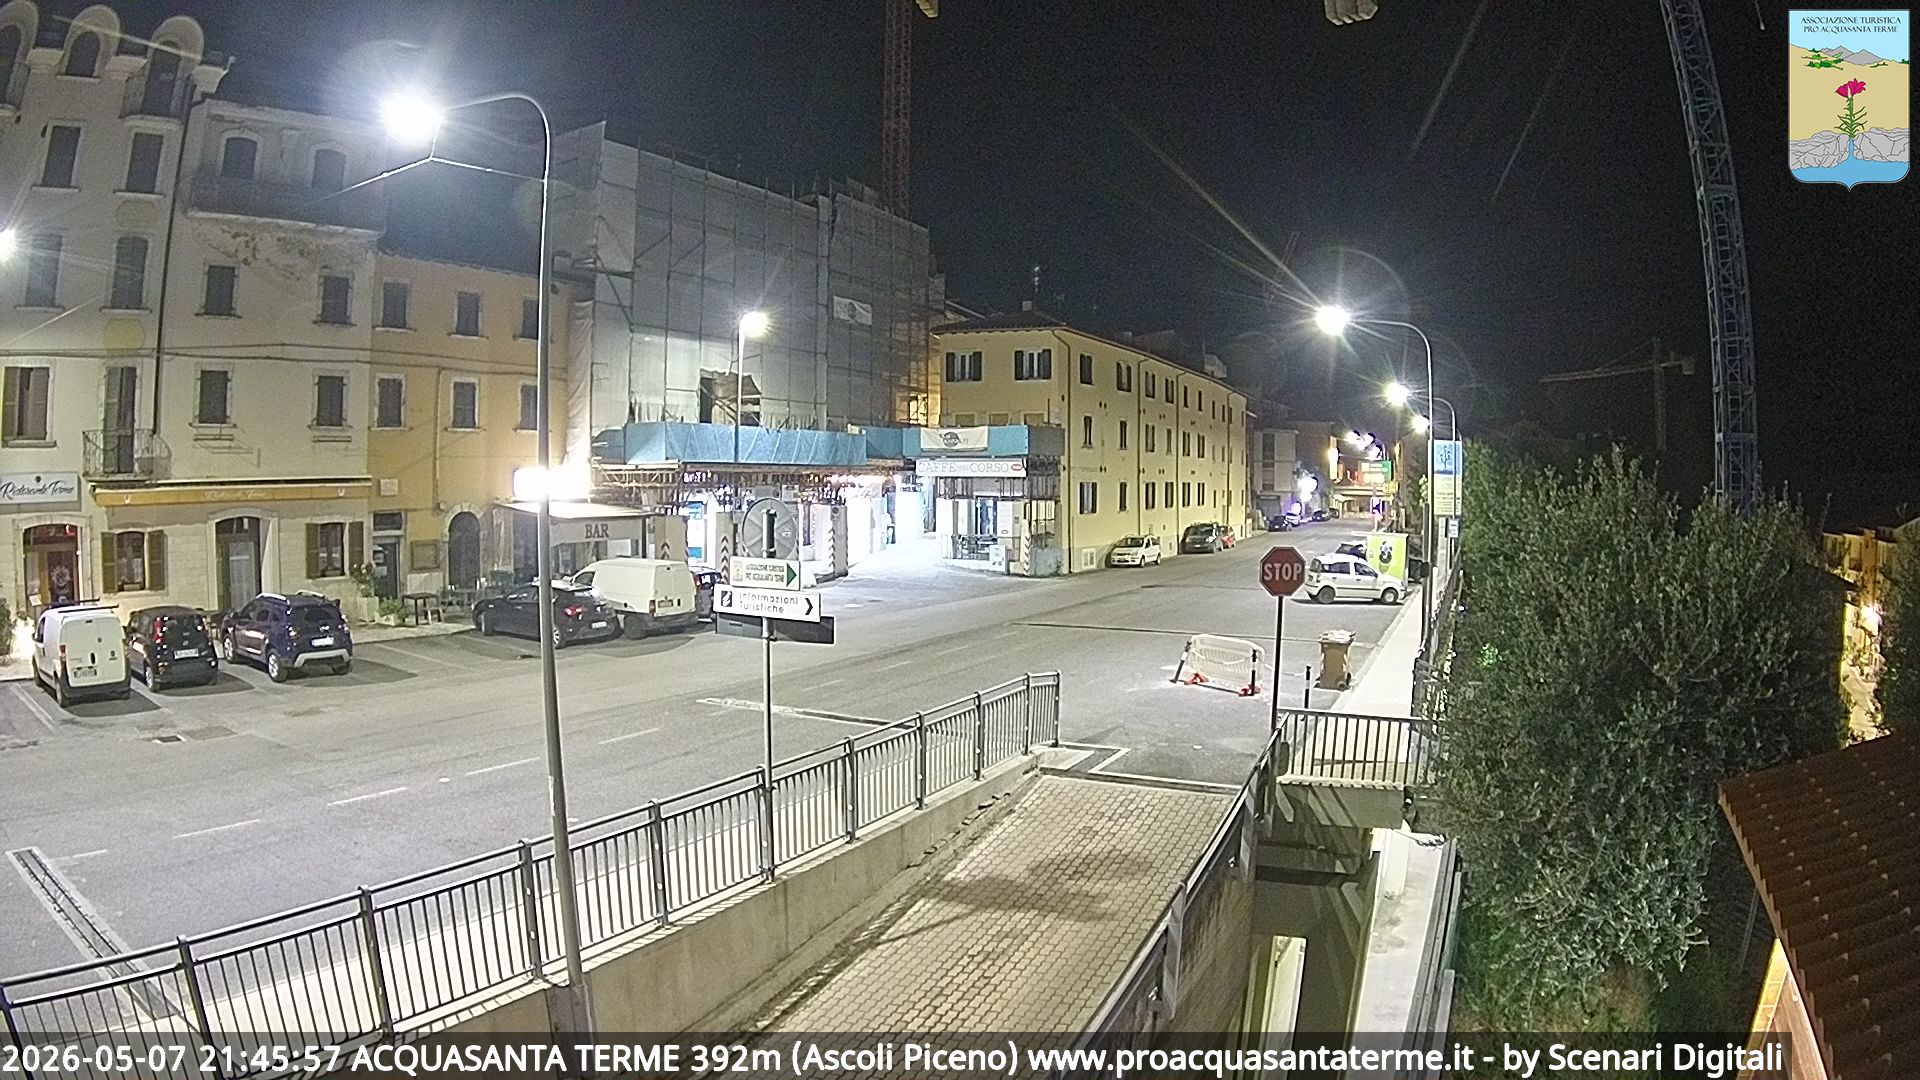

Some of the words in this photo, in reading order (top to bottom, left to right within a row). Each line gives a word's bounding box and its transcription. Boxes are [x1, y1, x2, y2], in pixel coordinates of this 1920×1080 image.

[969, 462, 1009, 473] CORSO
[585, 523, 609, 538] BAR
[1264, 562, 1302, 581] STOP
[740, 592, 798, 605] Informazioni
[740, 600, 784, 613] Turistiche
